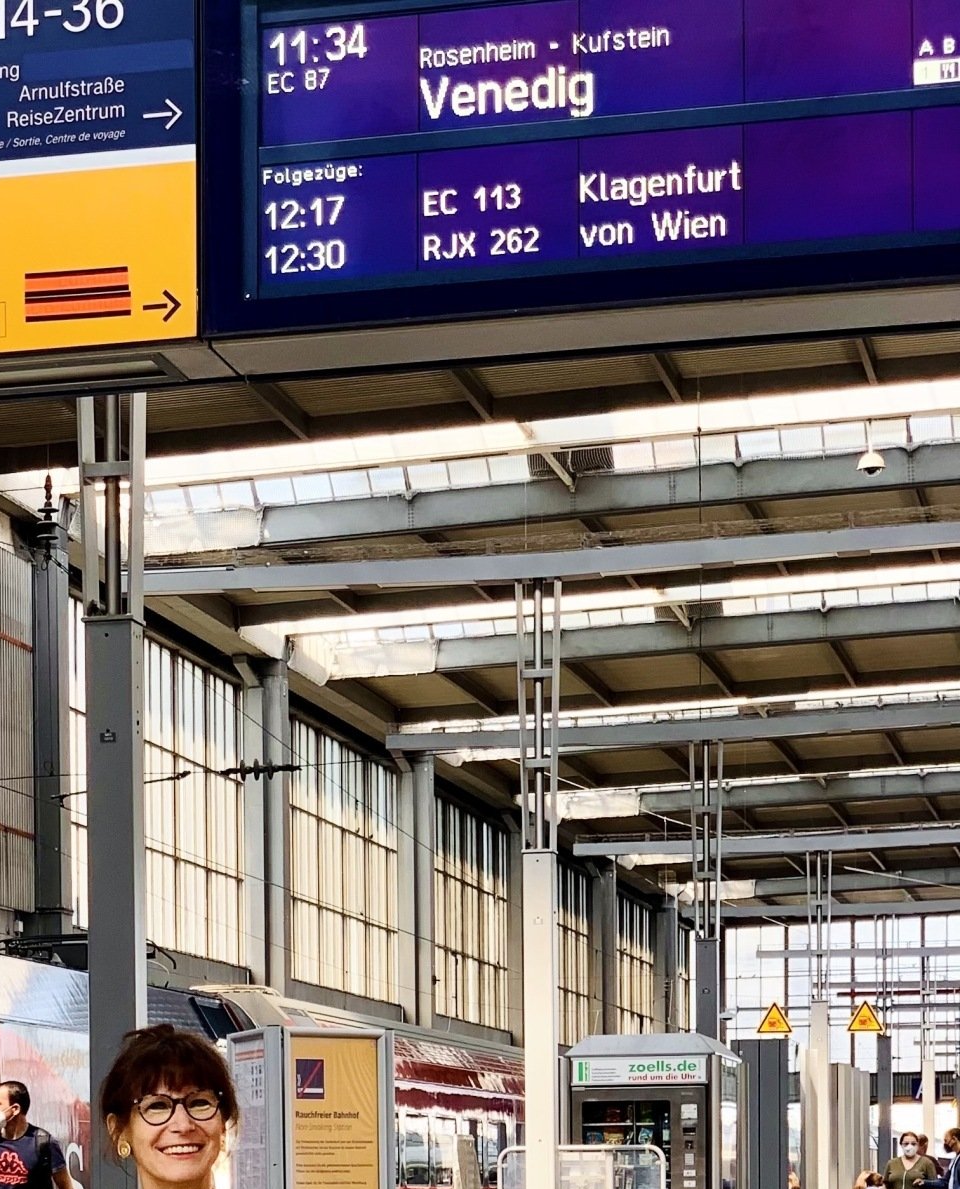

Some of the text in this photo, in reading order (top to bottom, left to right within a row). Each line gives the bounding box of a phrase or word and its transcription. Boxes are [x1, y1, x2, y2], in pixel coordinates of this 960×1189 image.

[268, 24, 368, 67] 11:34
[419, 39, 536, 69] Rosenheim
[571, 26, 671, 55] Kufstein
[918, 37, 956, 57] A B
[18, 76, 125, 102] Arnulfstraße
[267, 68, 331, 95] EC 87
[419, 65, 594, 120] Venedig
[6, 103, 125, 129] ReiseZentrum
[45, 133, 76, 145] Centre
[78, 131, 91, 142] de
[93, 128, 126, 142] voyage
[262, 163, 363, 187] Folgezüge:
[264, 159, 741, 231] 12:17 EC 113 Klagenfurt
[264, 209, 727, 275] 12:30 RJX 262 von Wien
[628, 1059, 697, 1073] zoells.de
[628, 1073, 648, 1081] rund
[665, 1072, 679, 1081] die
[681, 1072, 696, 1080] Uhr
[295, 1110, 360, 1119] Rauchfreier Bahnhof
